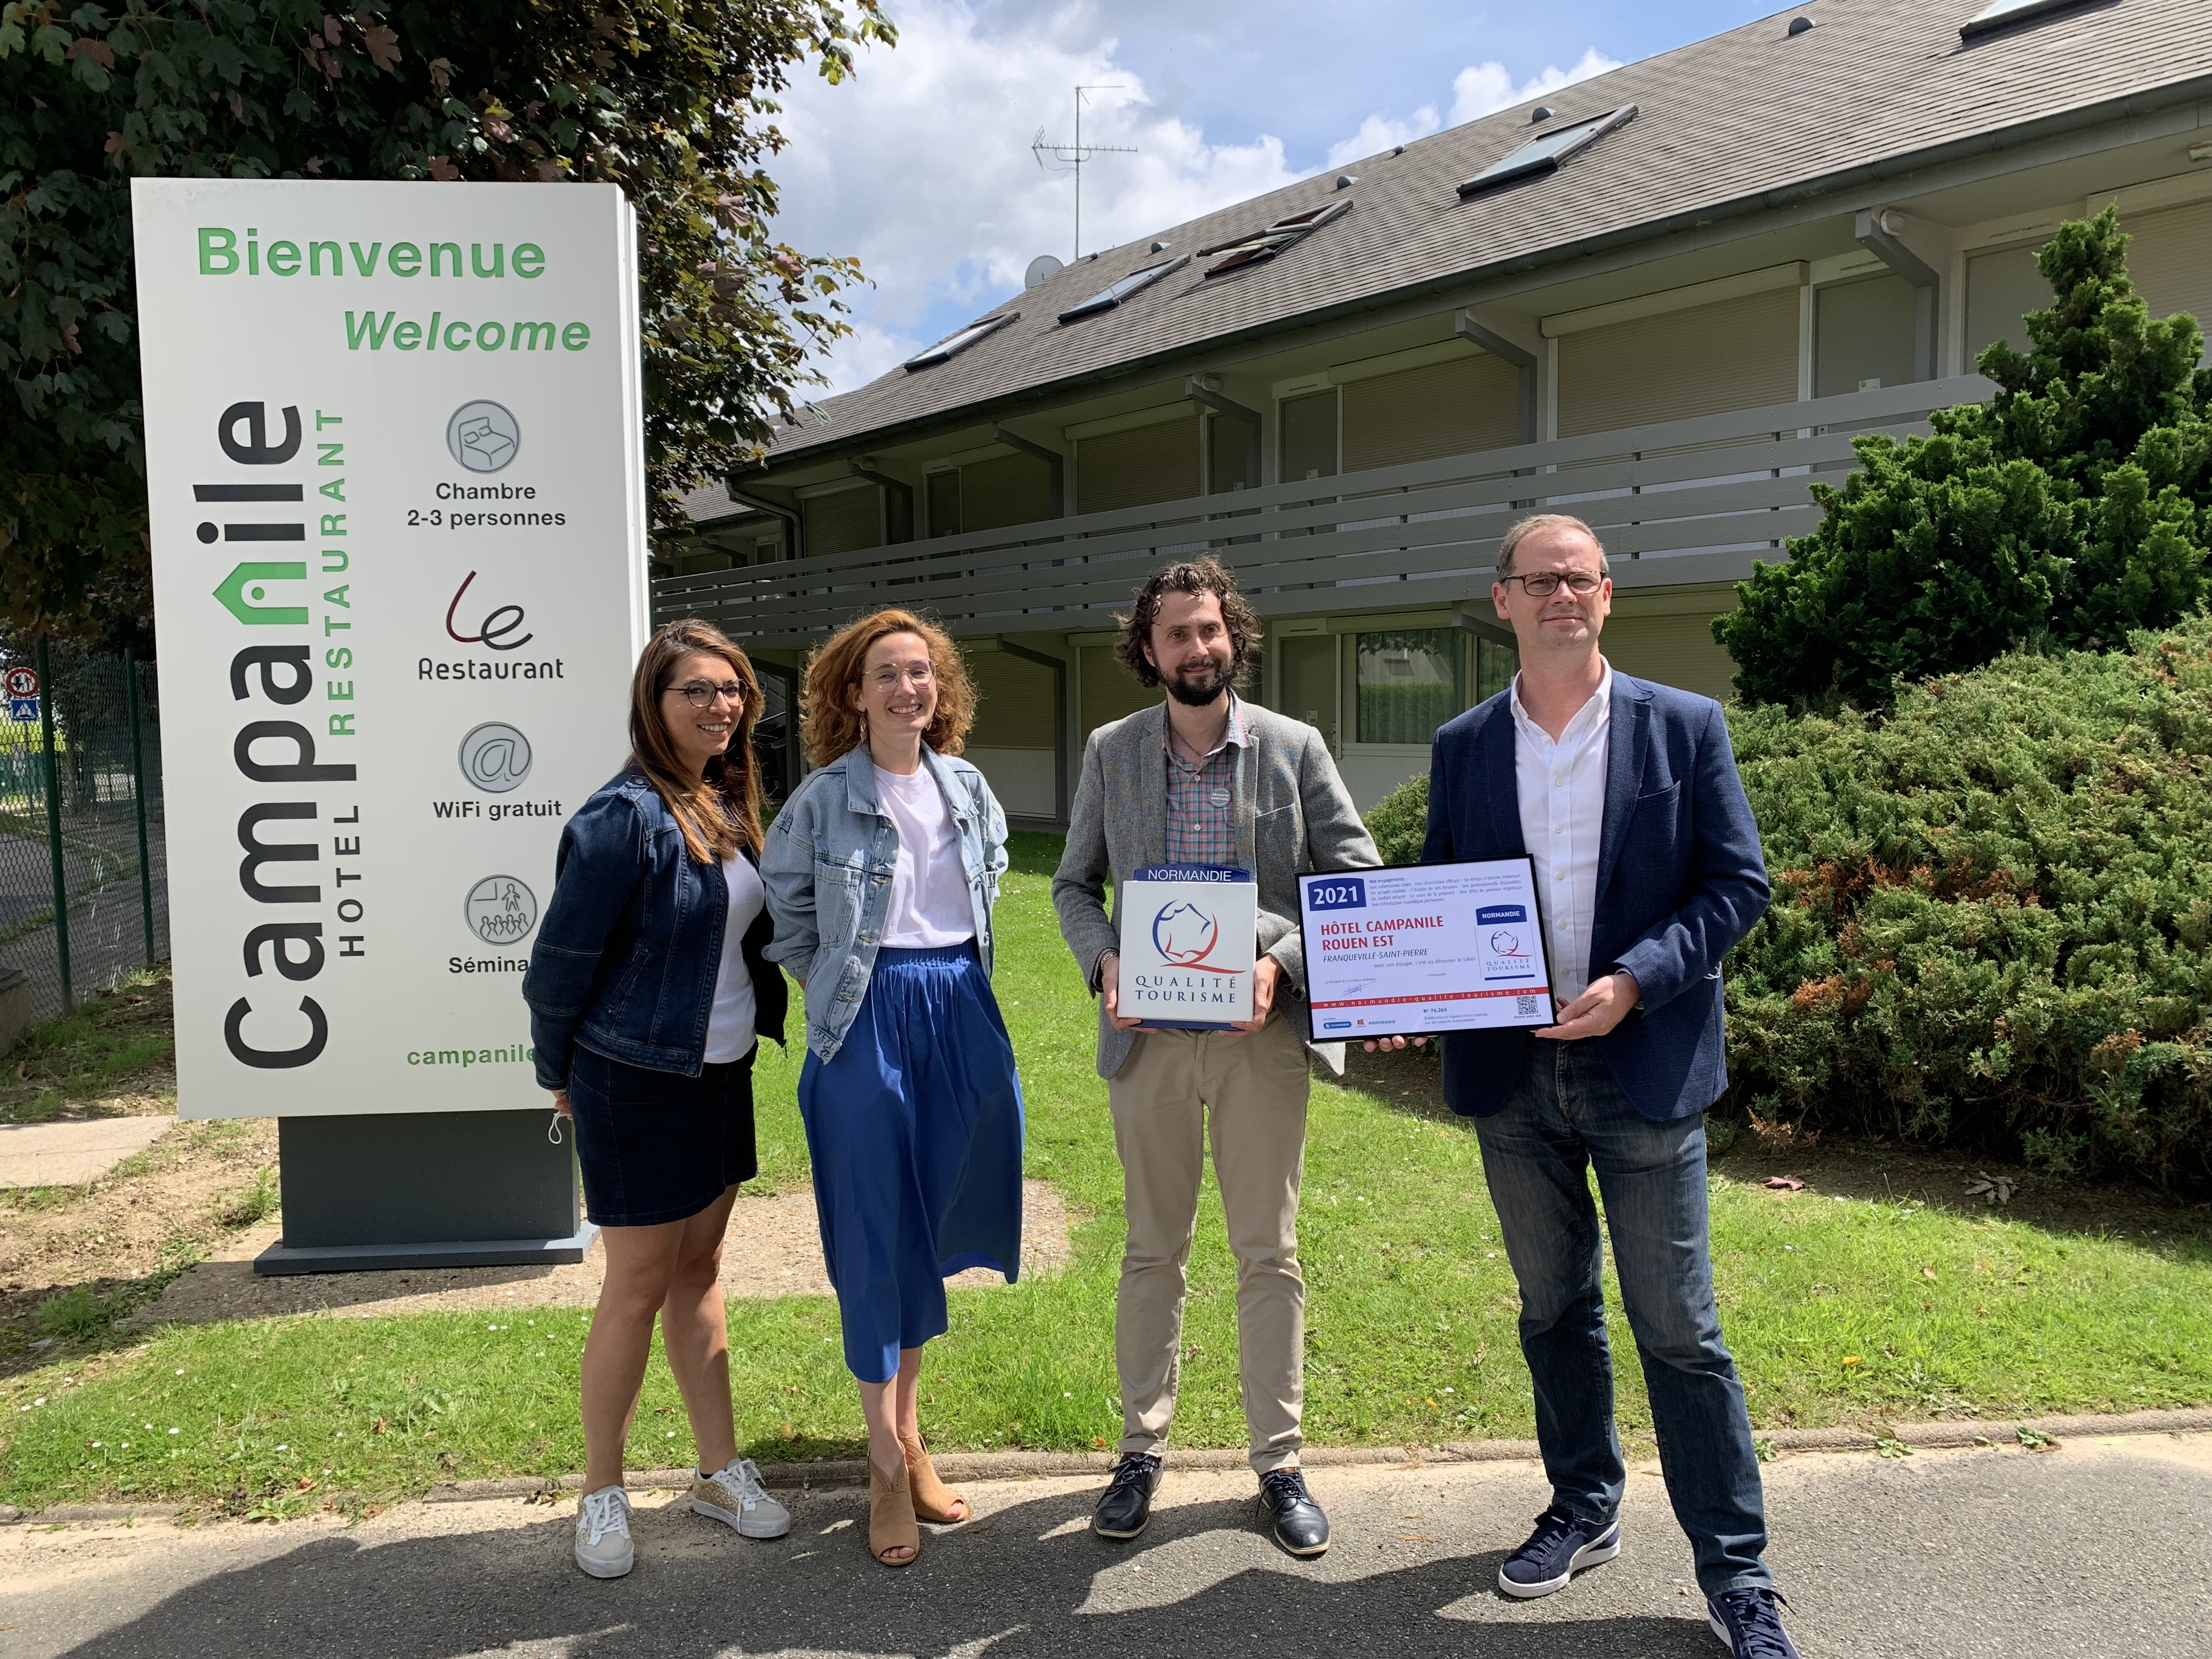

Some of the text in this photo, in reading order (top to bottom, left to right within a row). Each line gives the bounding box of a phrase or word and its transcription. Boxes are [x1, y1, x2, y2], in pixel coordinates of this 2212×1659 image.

[198, 228, 546, 278] Bienvenue
[345, 311, 591, 351] Welcome
[436, 482, 537, 500] Chambre
[407, 510, 566, 531] 2-3 personnes
[419, 658, 564, 680] Restaurant
[316, 409, 365, 957] HOTEL RESTAURANT
[433, 800, 562, 821] WiFi gratuit
[1148, 869, 1232, 882] NORMANDIE
[1313, 885, 1358, 905] 2021
[1482, 911, 1521, 919] NORMANDIE
[1321, 916, 1444, 935] HÔTEL CAMPANILE
[1322, 935, 1394, 951] ROUEN EST
[1323, 949, 1429, 963] FRANQUEVILLE-SAINT-PIERRE
[1136, 975, 1236, 989] QUALITÉ
[1135, 990, 1235, 1003] TOURISME
[1323, 989, 1536, 1007] www.normandie-qualite-tourisme.com
